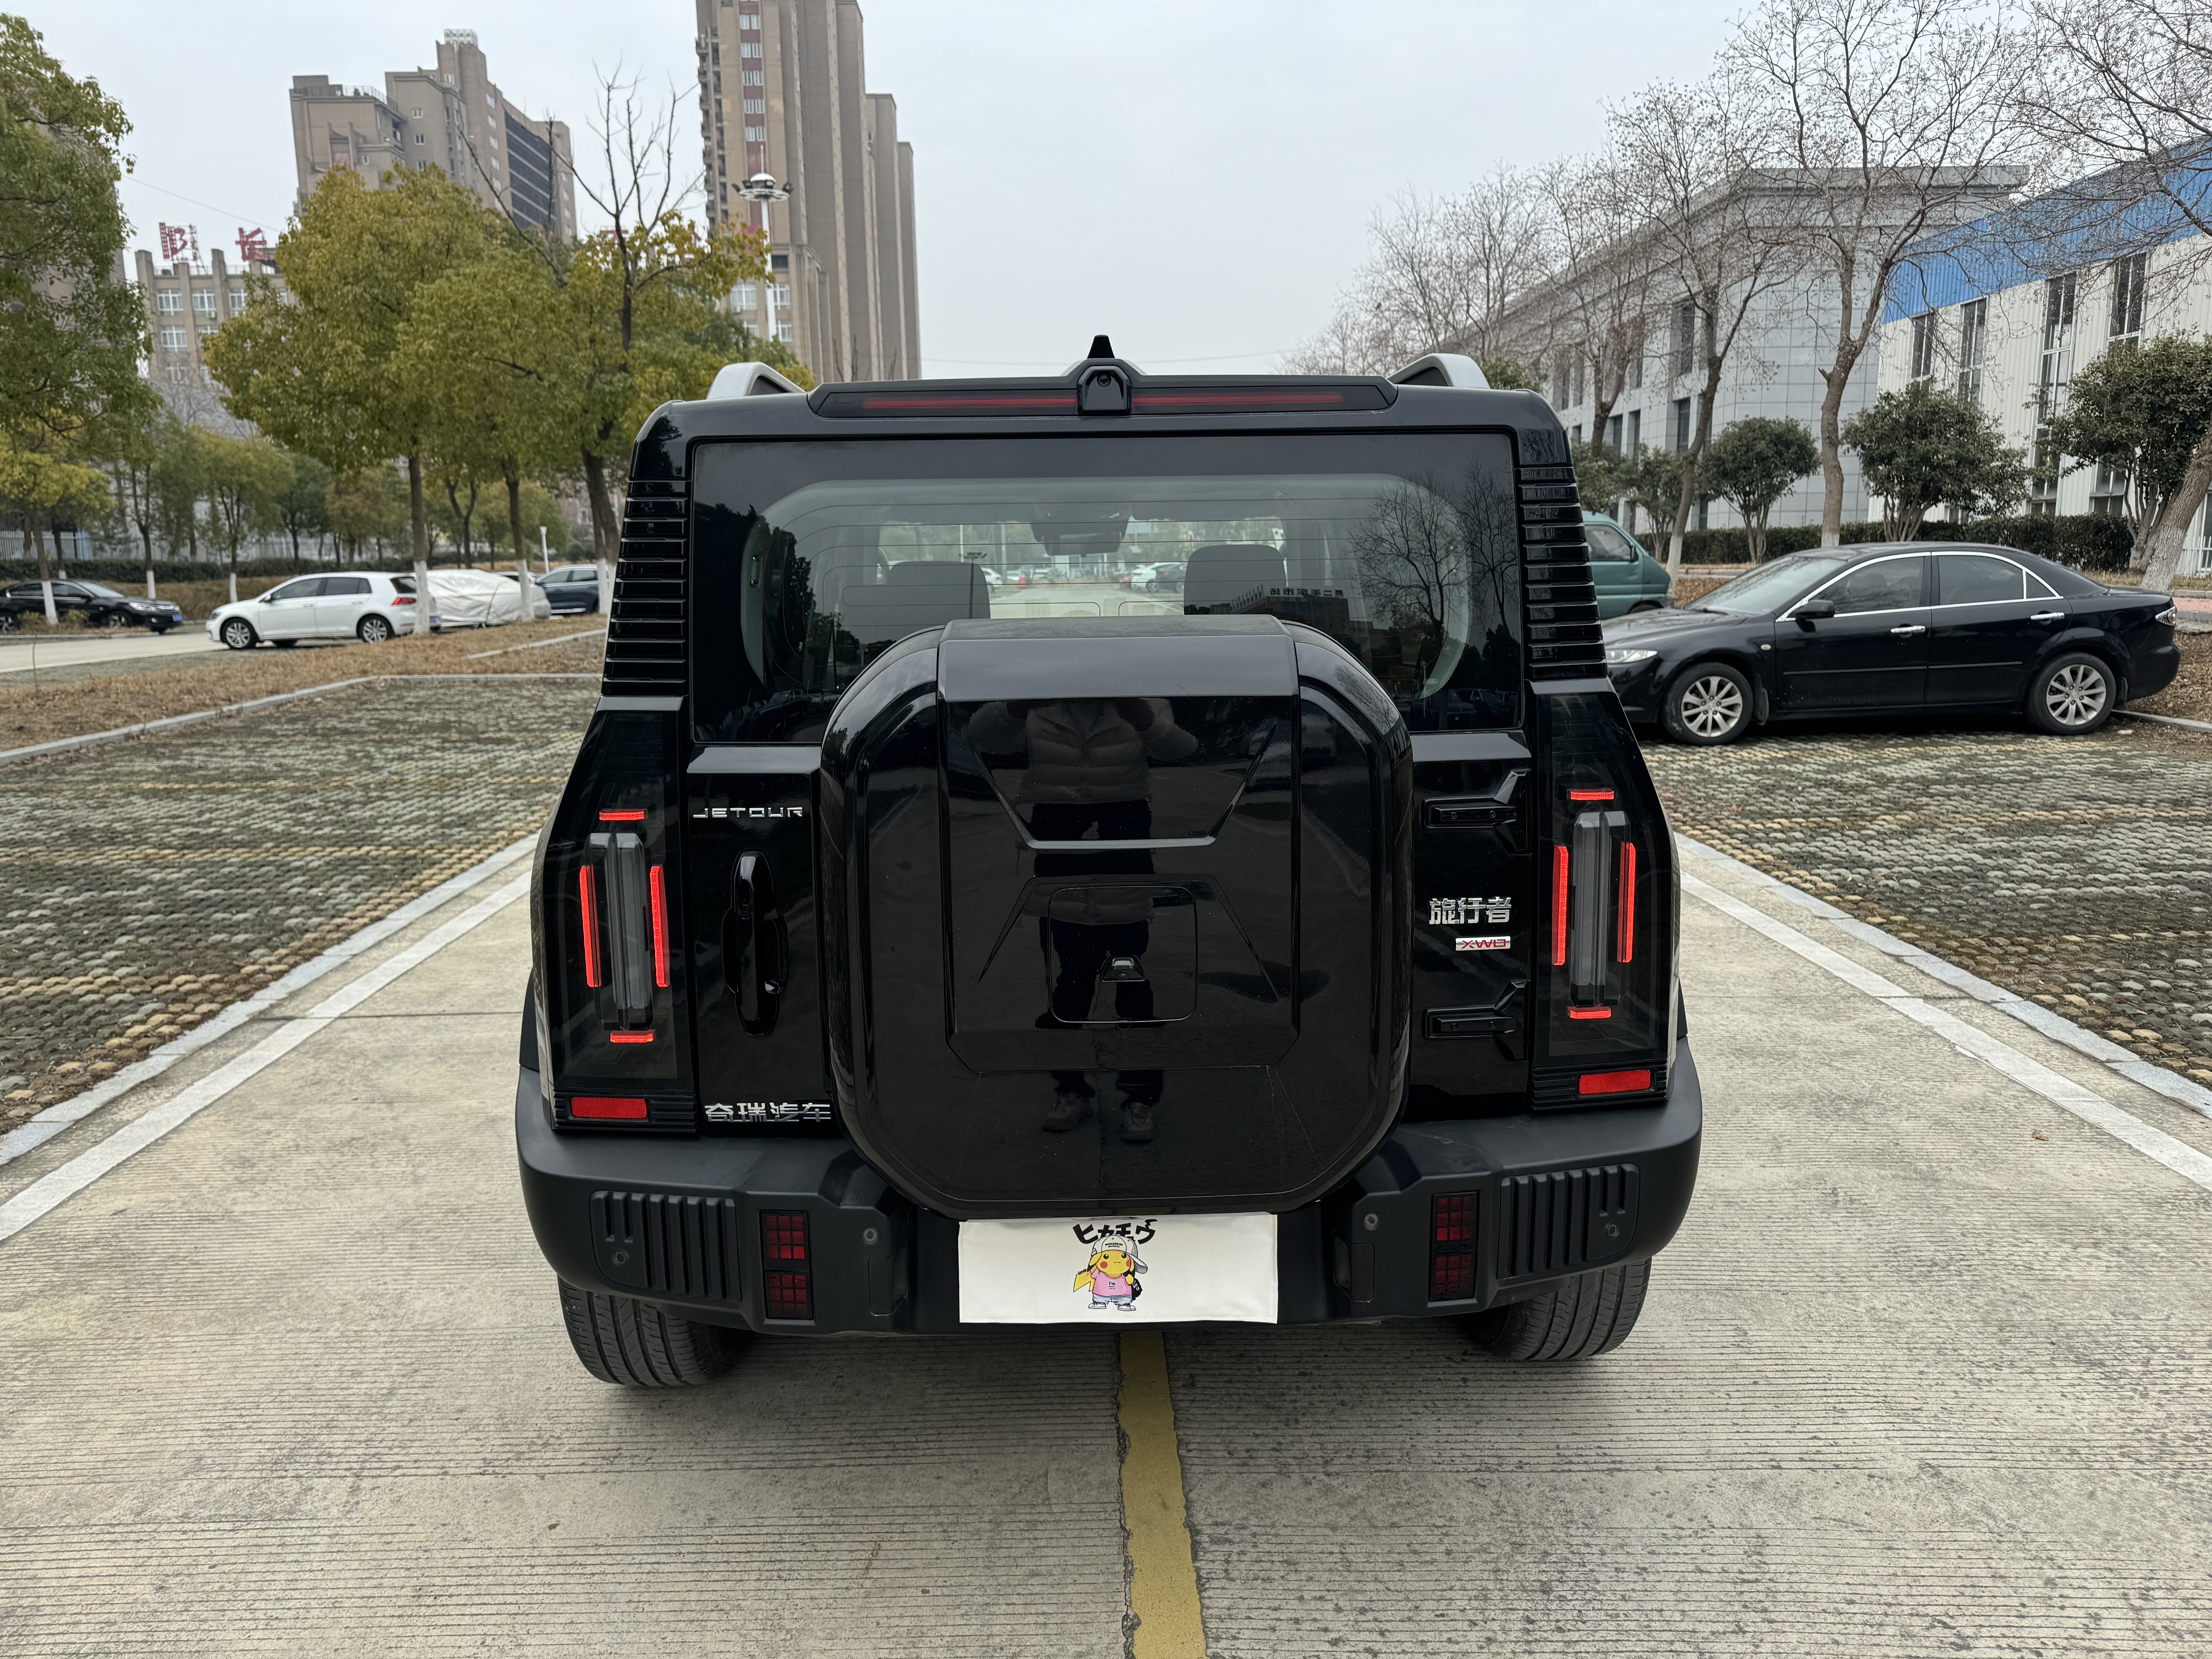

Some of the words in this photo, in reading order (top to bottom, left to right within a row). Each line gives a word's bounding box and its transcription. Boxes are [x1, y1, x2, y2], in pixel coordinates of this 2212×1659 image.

[693, 807, 803, 818] JETOUR
[1429, 896, 1512, 925] 旅行者
[1461, 939, 1506, 949] XWD
[704, 1102, 831, 1122] 奇瑞汽车
